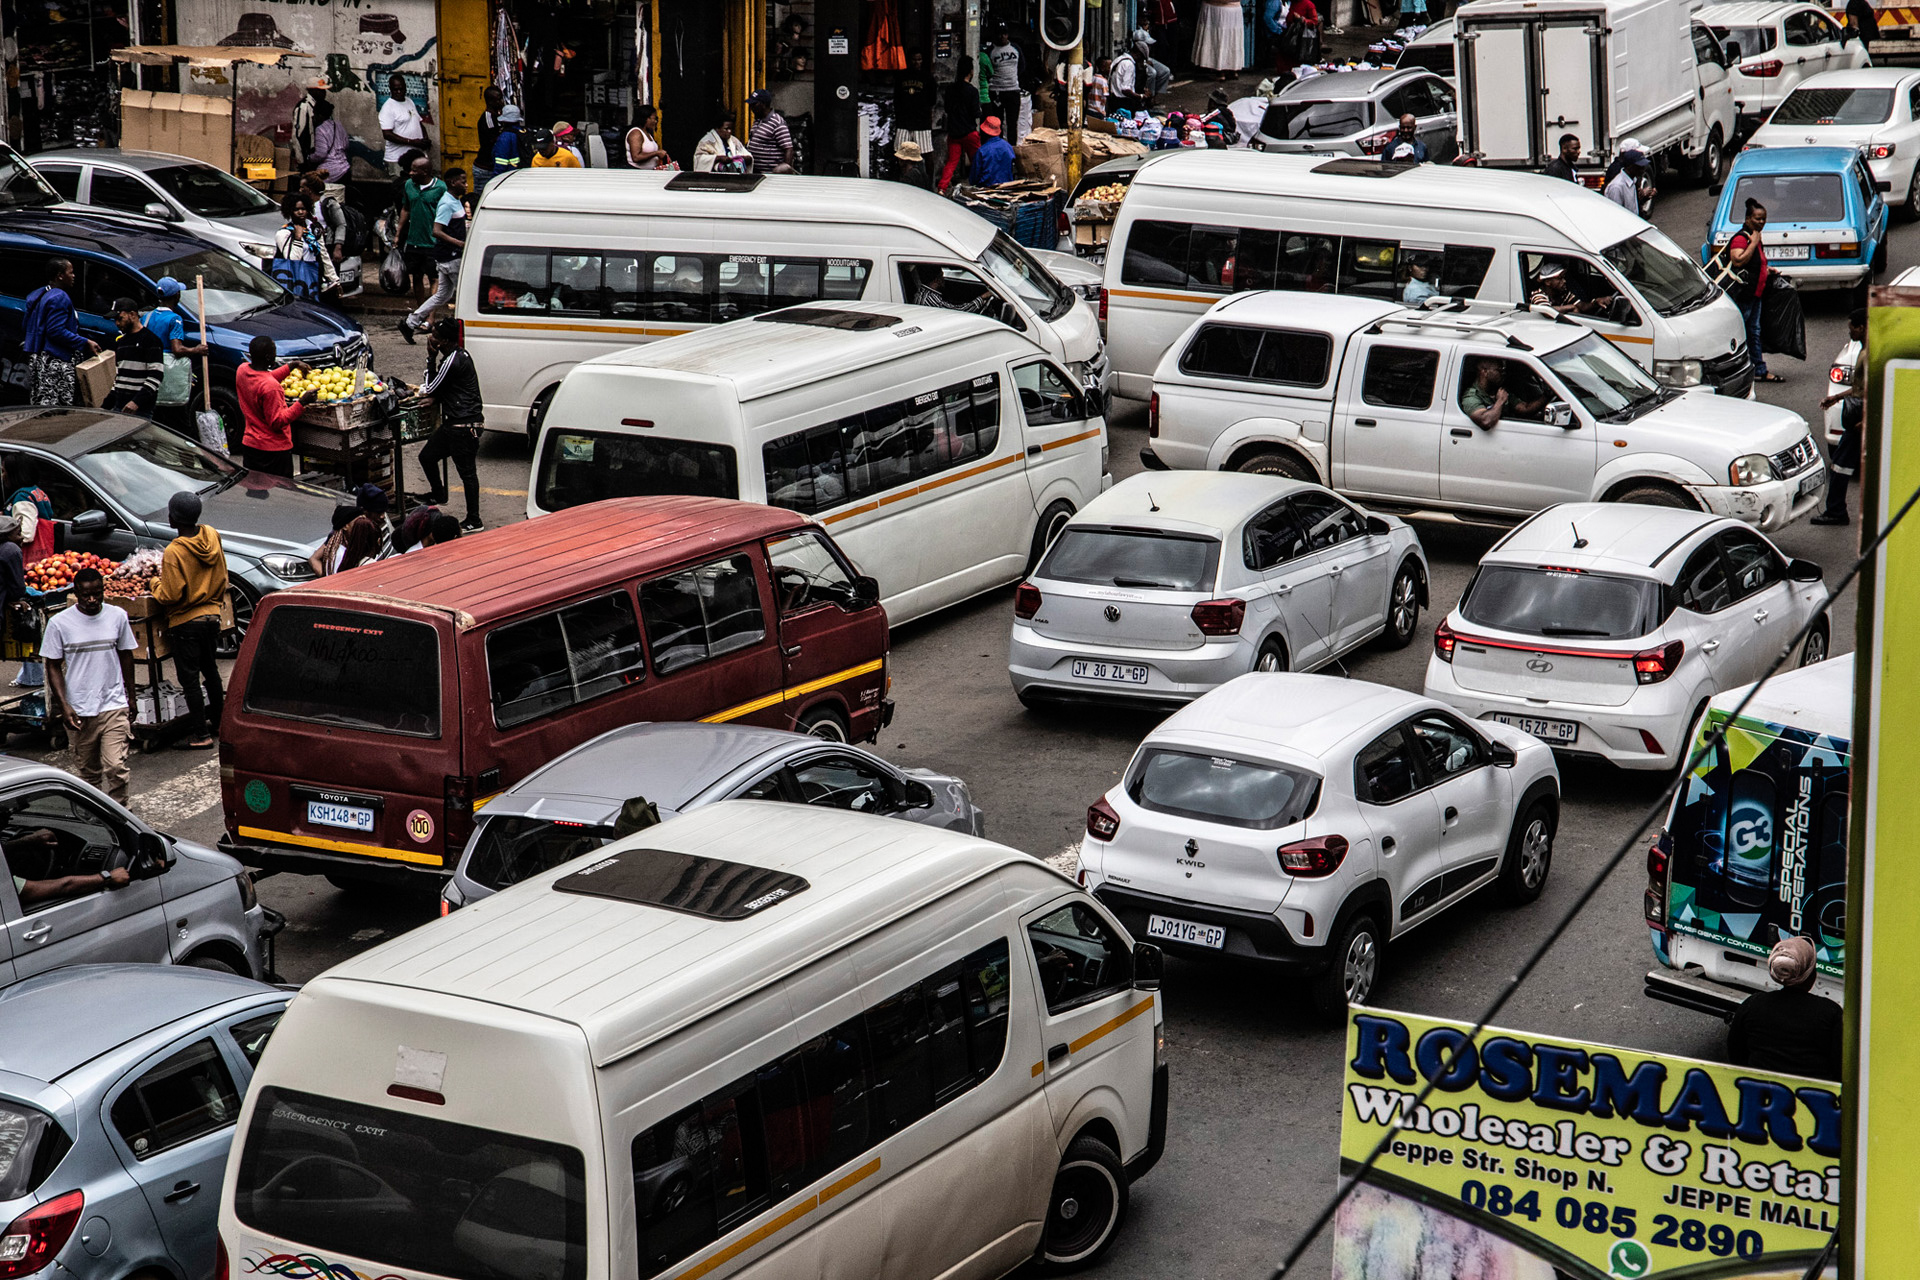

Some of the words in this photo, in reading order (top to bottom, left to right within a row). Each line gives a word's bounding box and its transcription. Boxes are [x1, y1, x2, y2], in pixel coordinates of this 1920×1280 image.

[729, 255, 756, 263] EMERGENCY
[757, 256, 767, 264] EXIT
[827, 258, 860, 267] NOODUITGANG
[313, 623, 361, 633] EMERGENCY
[1074, 661, 1087, 676] JY
[1093, 664, 1107, 678] 30
[1112, 665, 1125, 679] ZL
[1132, 667, 1146, 681] GP
[1558, 723, 1574, 738] GP
[319, 793, 349, 802] TOYOTA
[309, 802, 350, 824] KSH148
[357, 811, 371, 827] GP
[411, 818, 429, 835] 100
[1732, 814, 1771, 850] G3
[1176, 858, 1206, 868] KWID
[1780, 799, 1799, 903] SPECIAL
[1790, 776, 1812, 932] OPERATIONS
[1107, 874, 1131, 884] RENAULT
[1149, 917, 1197, 941] LJ91YG
[1206, 928, 1222, 946] GP
[1727, 938, 1766, 954] CONTROL
[1350, 1014, 1841, 1158] ROSEMARY
[272, 1108, 351, 1130] EMERGENCY
[355, 1124, 388, 1137] EXIT
[1348, 1083, 1631, 1167] Wholesaler
[1641, 1134, 1692, 1176] &
[1461, 1148, 1505, 1174] Str.
[1514, 1157, 1579, 1190] Shop
[1587, 1170, 1614, 1194] N.
[1461, 1180, 1542, 1222] 084
[1555, 1196, 1637, 1239] 085
[1650, 1214, 1764, 1261] 2890
[1663, 1184, 1751, 1218] JEPPE
[1760, 1201, 1840, 1233] MALL
